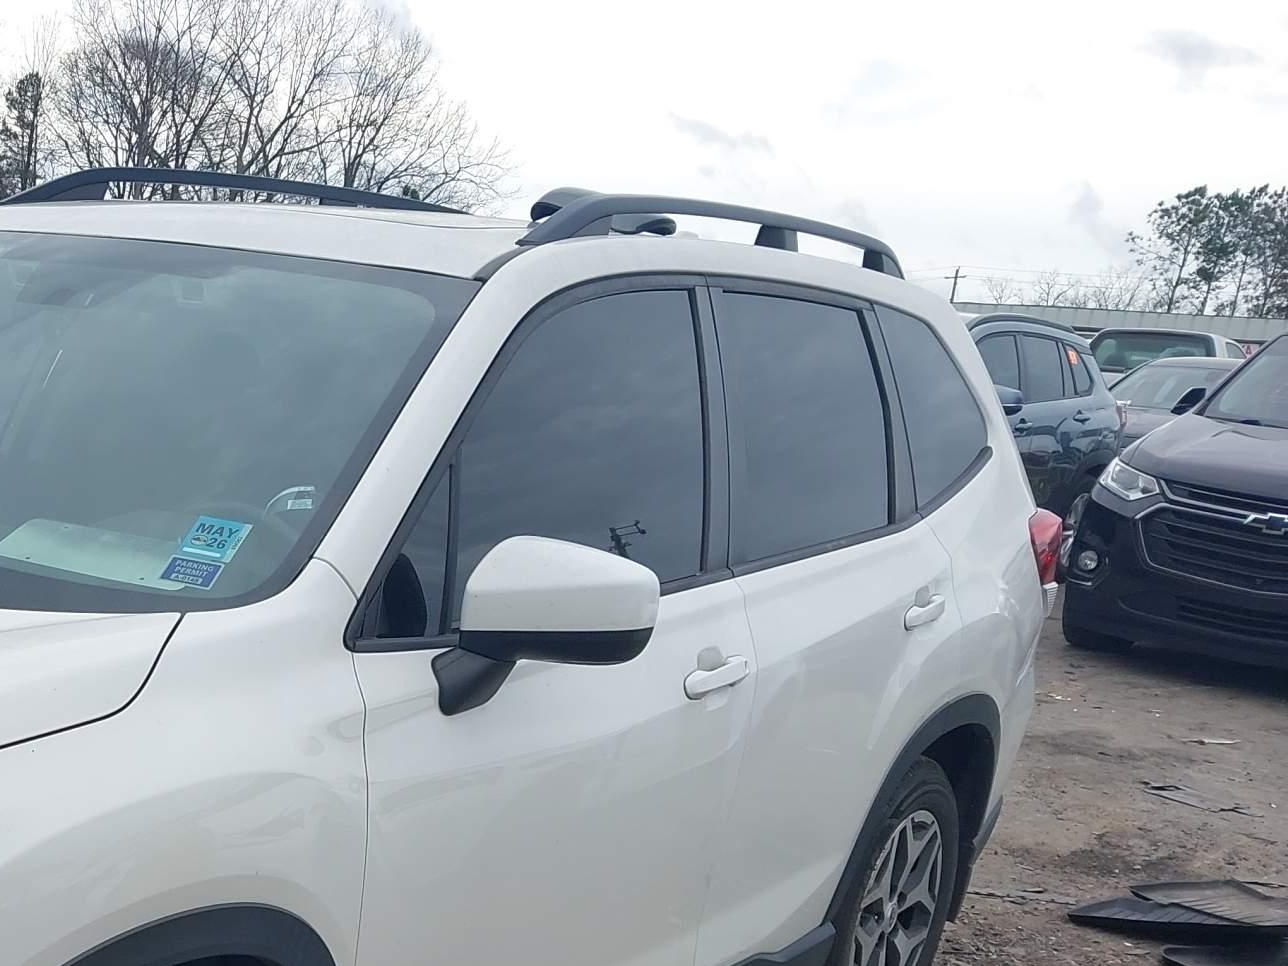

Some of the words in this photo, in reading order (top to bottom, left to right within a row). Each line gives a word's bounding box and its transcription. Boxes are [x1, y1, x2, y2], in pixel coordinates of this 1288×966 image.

[195, 522, 239, 539] MAY
[206, 537, 227, 549] 26
[174, 566, 209, 577] PERMIT
[175, 560, 214, 572] PARKING
